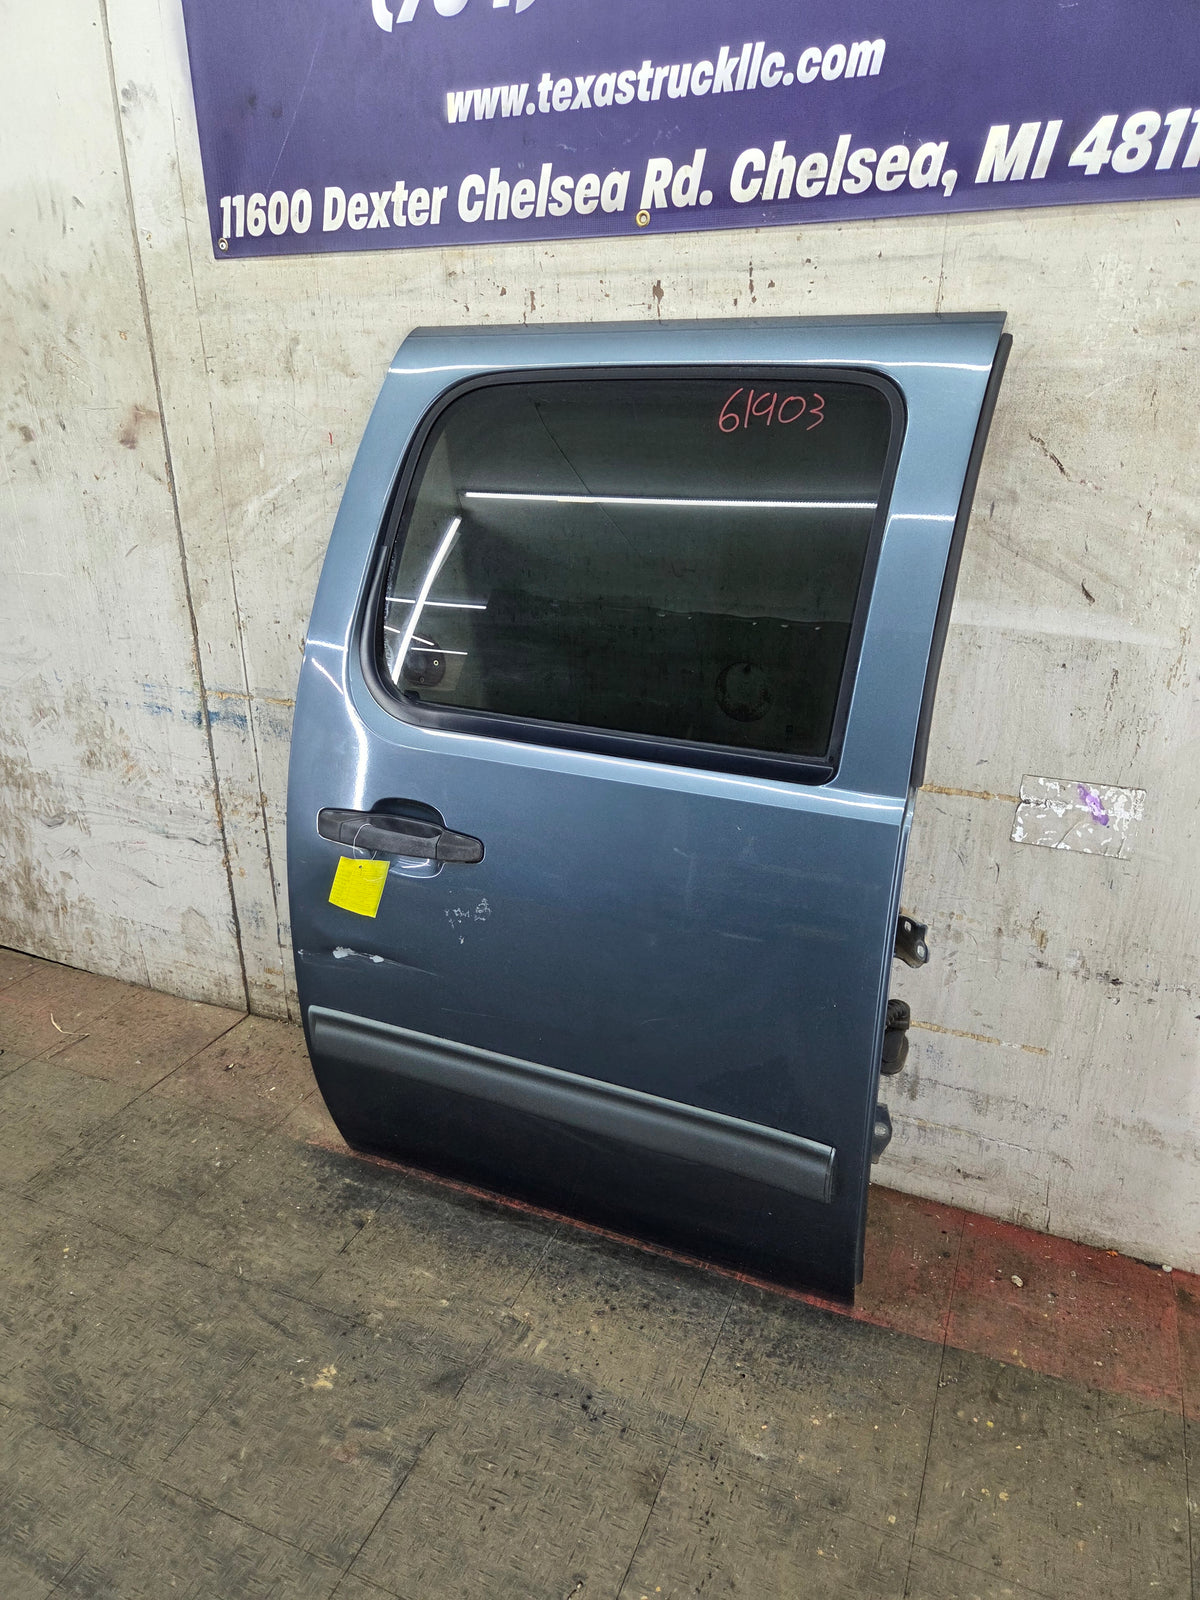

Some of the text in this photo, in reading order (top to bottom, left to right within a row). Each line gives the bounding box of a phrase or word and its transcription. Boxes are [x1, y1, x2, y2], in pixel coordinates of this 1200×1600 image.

[445, 38, 887, 124] www.texastruckllc.com
[219, 188, 313, 240] 11600
[322, 180, 448, 232] Dexter
[457, 163, 631, 224] Chelsea
[640, 147, 713, 210] Rd.
[729, 133, 959, 204] Chelsea,
[974, 120, 1064, 184] MI
[718, 387, 826, 433] 61903
